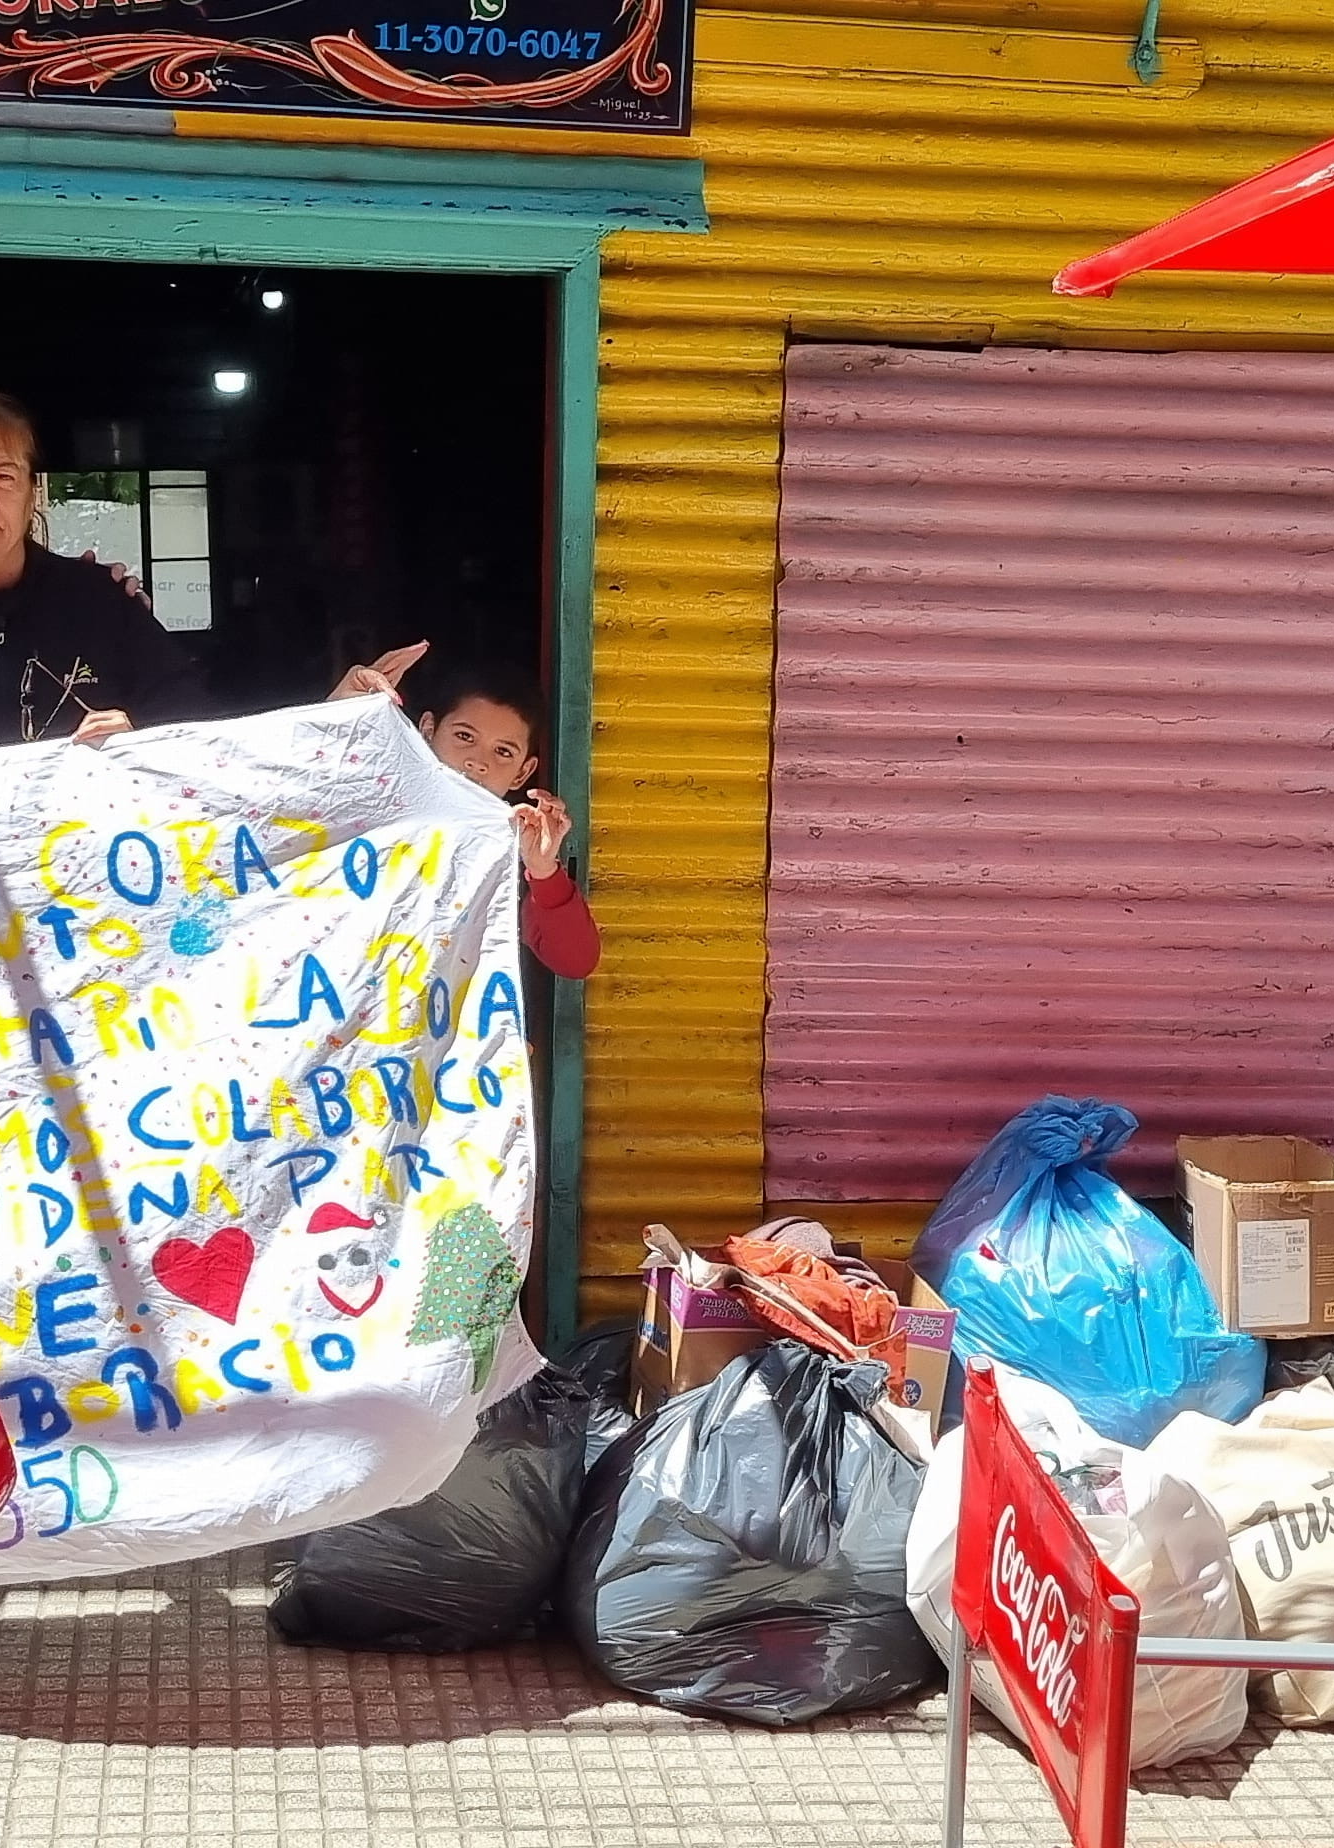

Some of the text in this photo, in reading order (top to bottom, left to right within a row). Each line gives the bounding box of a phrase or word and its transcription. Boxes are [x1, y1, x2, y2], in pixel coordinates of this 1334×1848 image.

[374, 22, 602, 60] 11-3070-6047
[243, 954, 347, 1029] LA
[991, 1504, 1086, 1728] Coca-Cola
